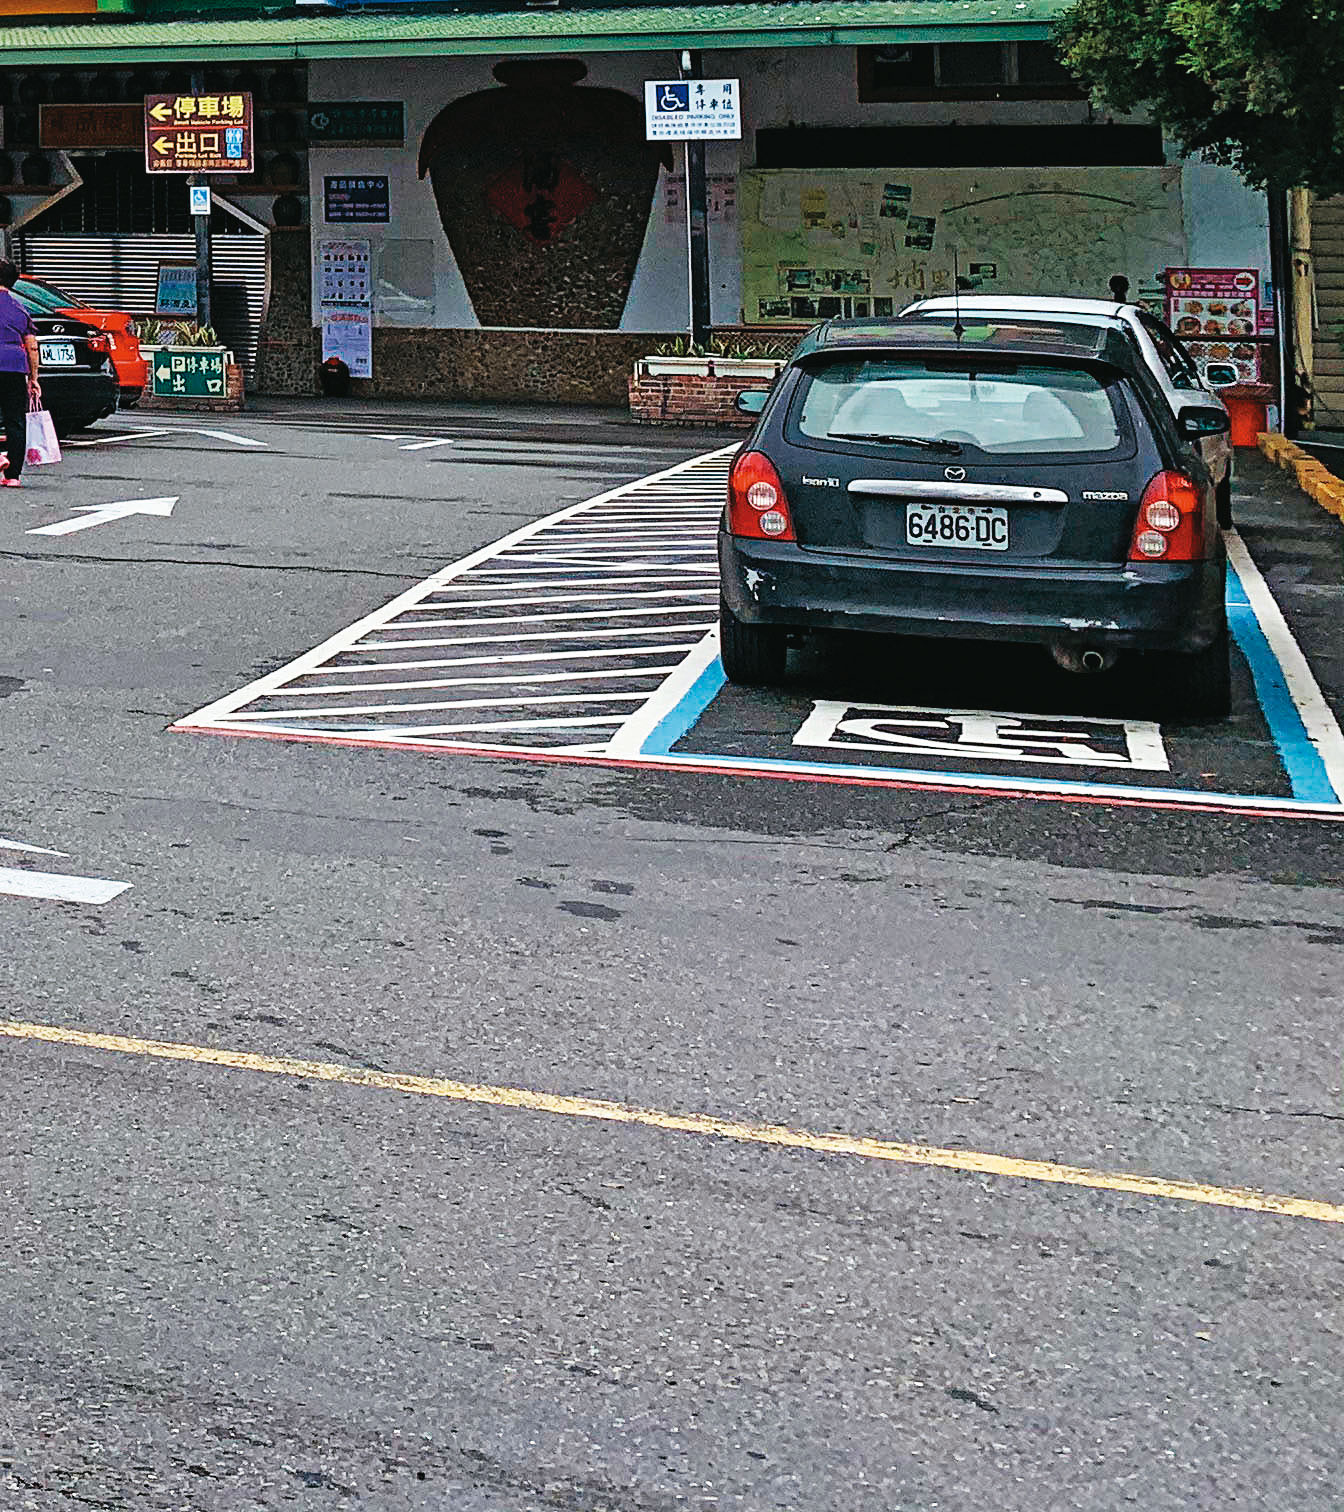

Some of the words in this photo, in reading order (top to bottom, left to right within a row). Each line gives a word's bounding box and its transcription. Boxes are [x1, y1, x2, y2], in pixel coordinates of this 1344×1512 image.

[173, 95, 244, 119] 停車場
[176, 131, 219, 153] 出口
[172, 374, 223, 393] 出口
[1082, 490, 1129, 502] mazda
[907, 512, 1008, 544] 6486-DC
